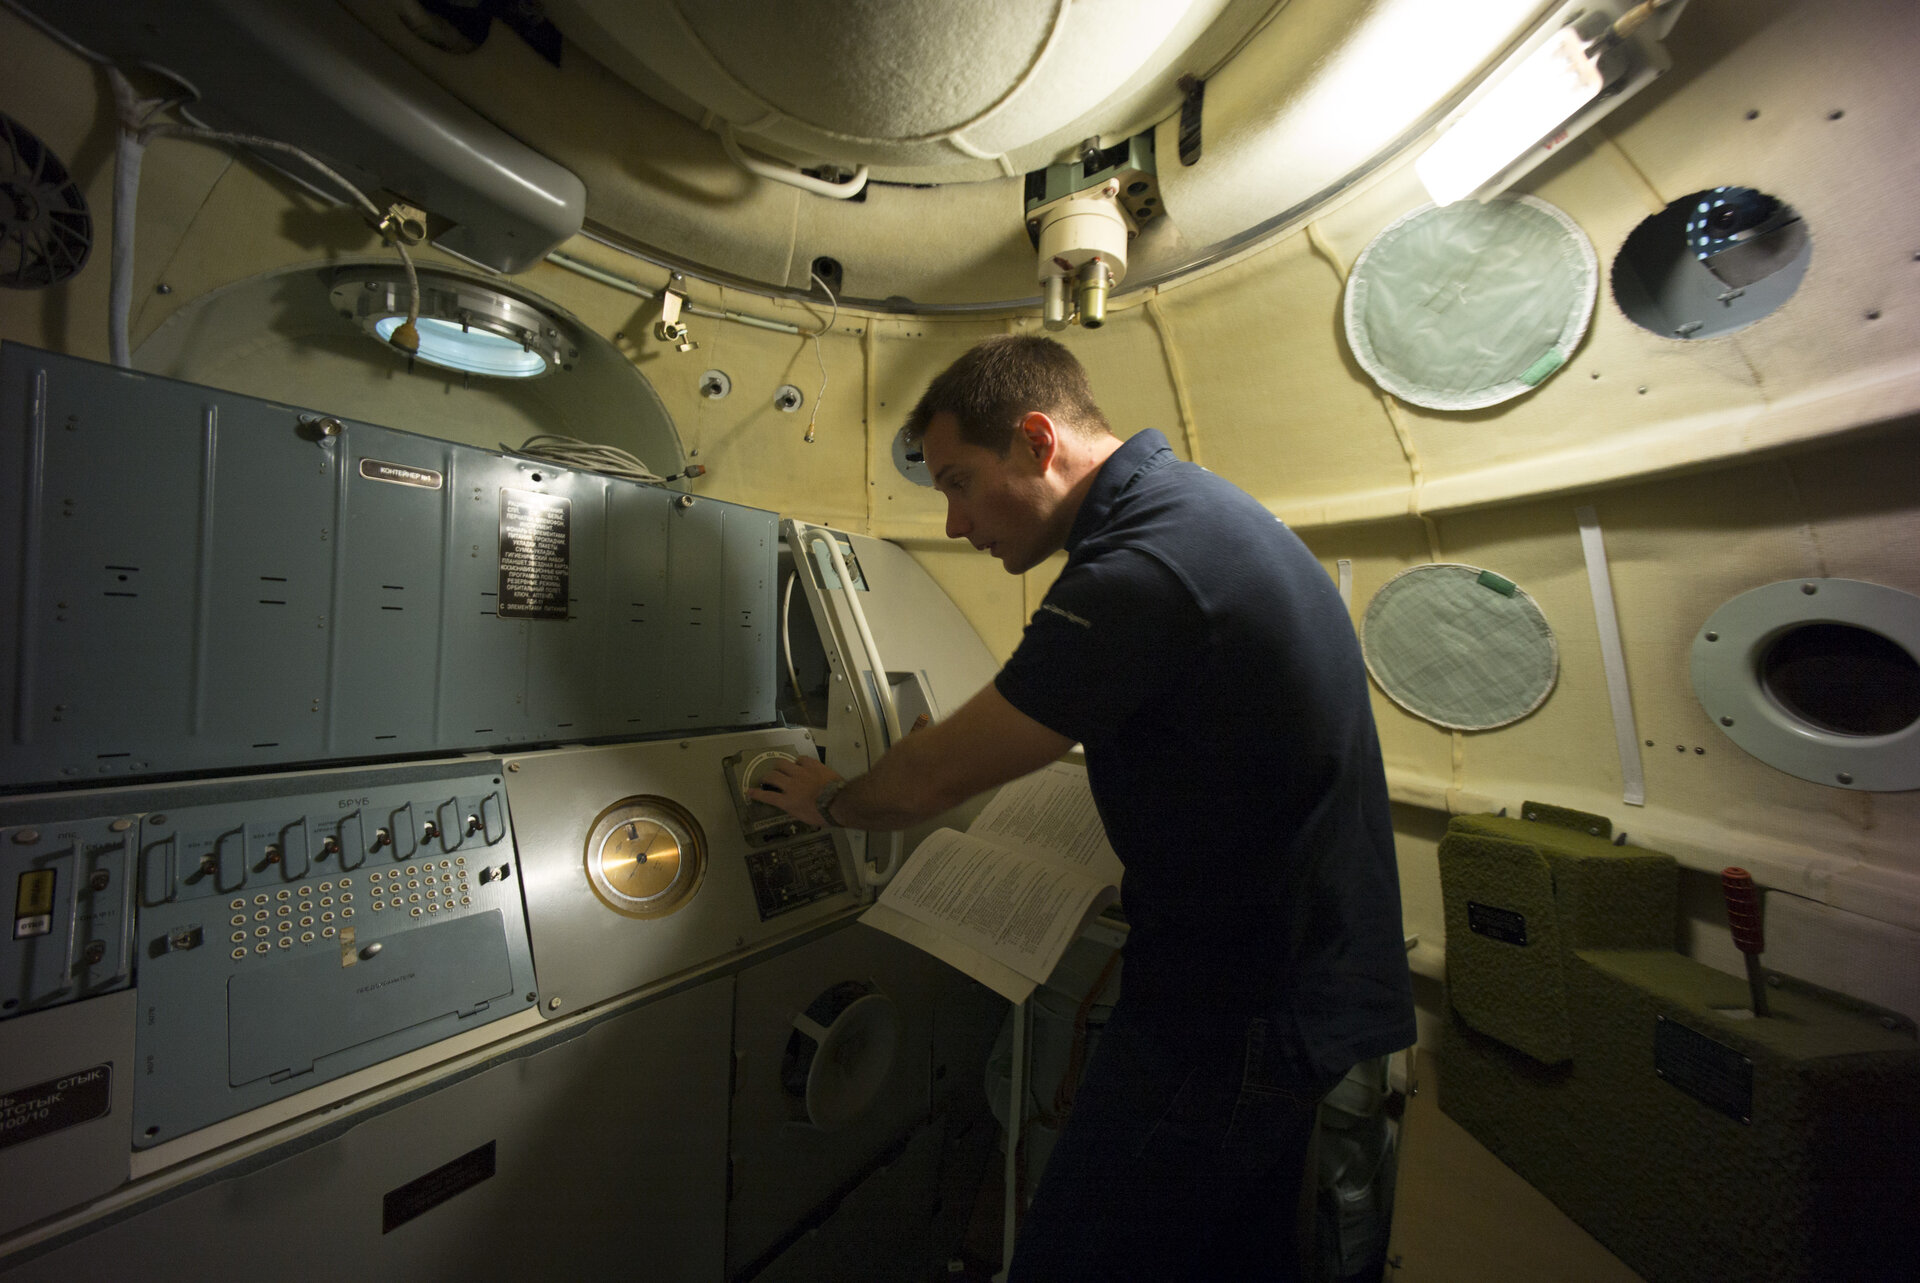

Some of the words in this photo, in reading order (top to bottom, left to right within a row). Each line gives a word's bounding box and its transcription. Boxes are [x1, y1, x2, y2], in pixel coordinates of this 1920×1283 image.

[380, 466, 421, 480] КОНТЕЙНЕР
[506, 584, 544, 593] ОРБИТАЛЬНЫЙ
[507, 603, 543, 612] ЭЛЕМЕНТАМИ
[338, 796, 370, 809] БРУБ
